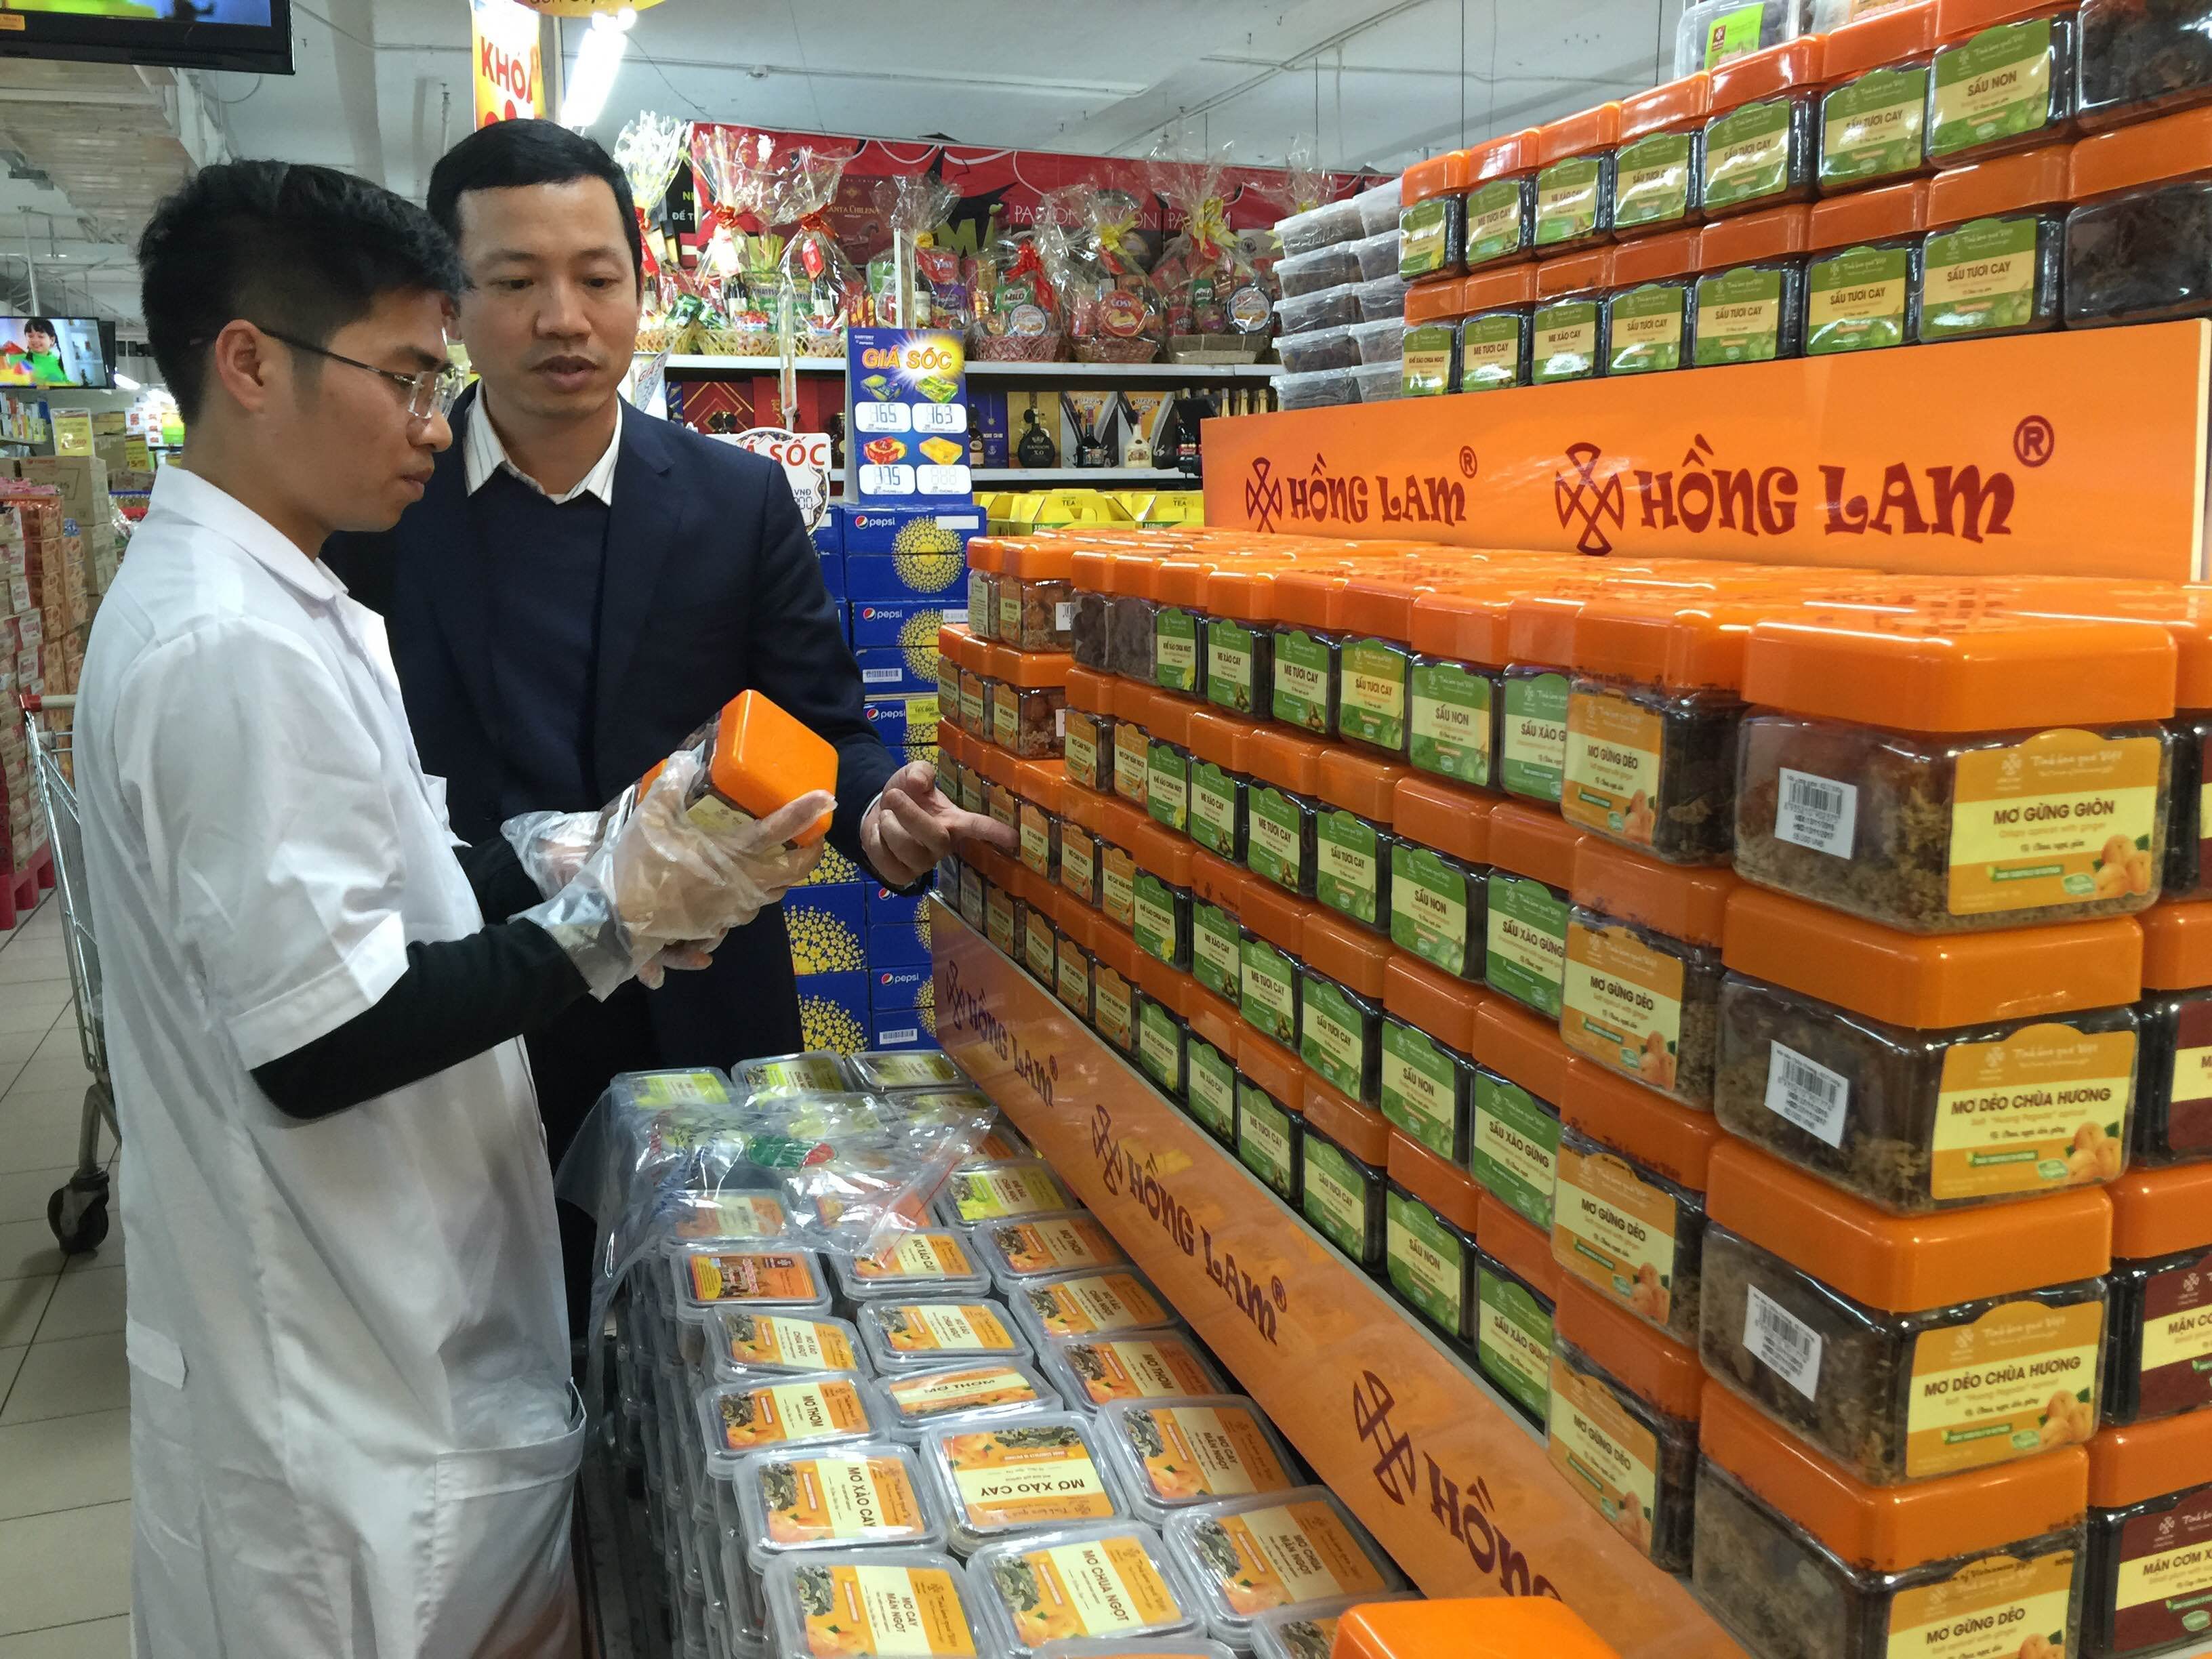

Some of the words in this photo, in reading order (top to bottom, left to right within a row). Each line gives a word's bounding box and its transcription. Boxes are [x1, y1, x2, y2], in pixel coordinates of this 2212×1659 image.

[1967, 76, 1989, 97] SẤU
[1992, 70, 2018, 90] NON
[862, 344, 901, 369] GIÁ
[874, 404, 897, 423] 165
[930, 405, 953, 424] 163
[769, 436, 827, 466] SỐC
[879, 466, 901, 486] 175
[1633, 433, 1799, 537] HỒNG
[1818, 462, 2015, 544] LAM
[1287, 452, 1369, 524] HỒNG
[1376, 474, 1467, 527] LAM
[869, 517, 895, 527] pepsi
[877, 609, 902, 619] pepsi
[880, 709, 905, 720] pepsi
[1435, 703, 1450, 722] SẤU
[1452, 710, 1469, 726] NON
[1521, 721, 1536, 737] SẤU
[1538, 723, 1556, 740] XÀO
[1993, 808, 2020, 824] MƠ
[2024, 802, 2070, 822] GỪNG
[2074, 797, 2115, 817] GIÒN
[1414, 888, 1429, 906] SẤU
[1430, 898, 1446, 915] NON
[1502, 920, 1518, 937] SẤU
[1520, 926, 1538, 945] XÀO
[1539, 935, 1563, 958] GỪNG
[895, 973, 919, 983] pepsi
[1590, 975, 1605, 991] MƠ
[1607, 982, 1633, 1003] GỪNG
[1635, 992, 1654, 1010] DẺO
[1403, 1067, 1416, 1086] SẤU
[1418, 1078, 1434, 1097] NON
[1951, 1099, 1975, 1115] MƠ
[1979, 1091, 2008, 1112] DẺO
[2014, 1089, 2052, 1109] CHÙA
[2057, 1087, 2111, 1105] HƯƠNG
[1490, 1120, 1504, 1139] SẤU
[1505, 1129, 1523, 1151] XÀO
[1525, 1141, 1549, 1168] GỪNG
[1582, 1198, 1597, 1214] MƠ
[1598, 1208, 1625, 1231] GỪNG
[1627, 1222, 1646, 1242] DẺO
[1126, 1152, 1195, 1256] HỒNG
[1200, 1225, 1277, 1345] LAM
[1409, 1238, 1422, 1256] SẤU
[1424, 1252, 1440, 1271] NON
[2168, 1318, 2195, 1334] MẬN
[1925, 1378, 1948, 1397] MƠ
[1952, 1371, 1982, 1391] DẺO
[1986, 1364, 2026, 1387] CHÙA
[2030, 1356, 2081, 1378] HƯƠNG
[848, 1467, 863, 1482] MƠ
[1058, 1479, 1085, 1492] MƠ
[853, 1484, 869, 1507] XÀO
[981, 1486, 1012, 1496] CAY
[1017, 1481, 1054, 1494] XÀO
[859, 1509, 876, 1528] CAY
[2143, 1556, 2170, 1576] MẬN
[2174, 1551, 2202, 1568] CƠM
[1082, 1550, 1099, 1564] MƠ
[1091, 1567, 1113, 1593] CHUA
[1105, 1595, 1130, 1622] NGỌT
[1925, 1626, 1950, 1645] MƠ
[1954, 1616, 1993, 1639] GỪNG
[1997, 1606, 2026, 1626] DẺO
